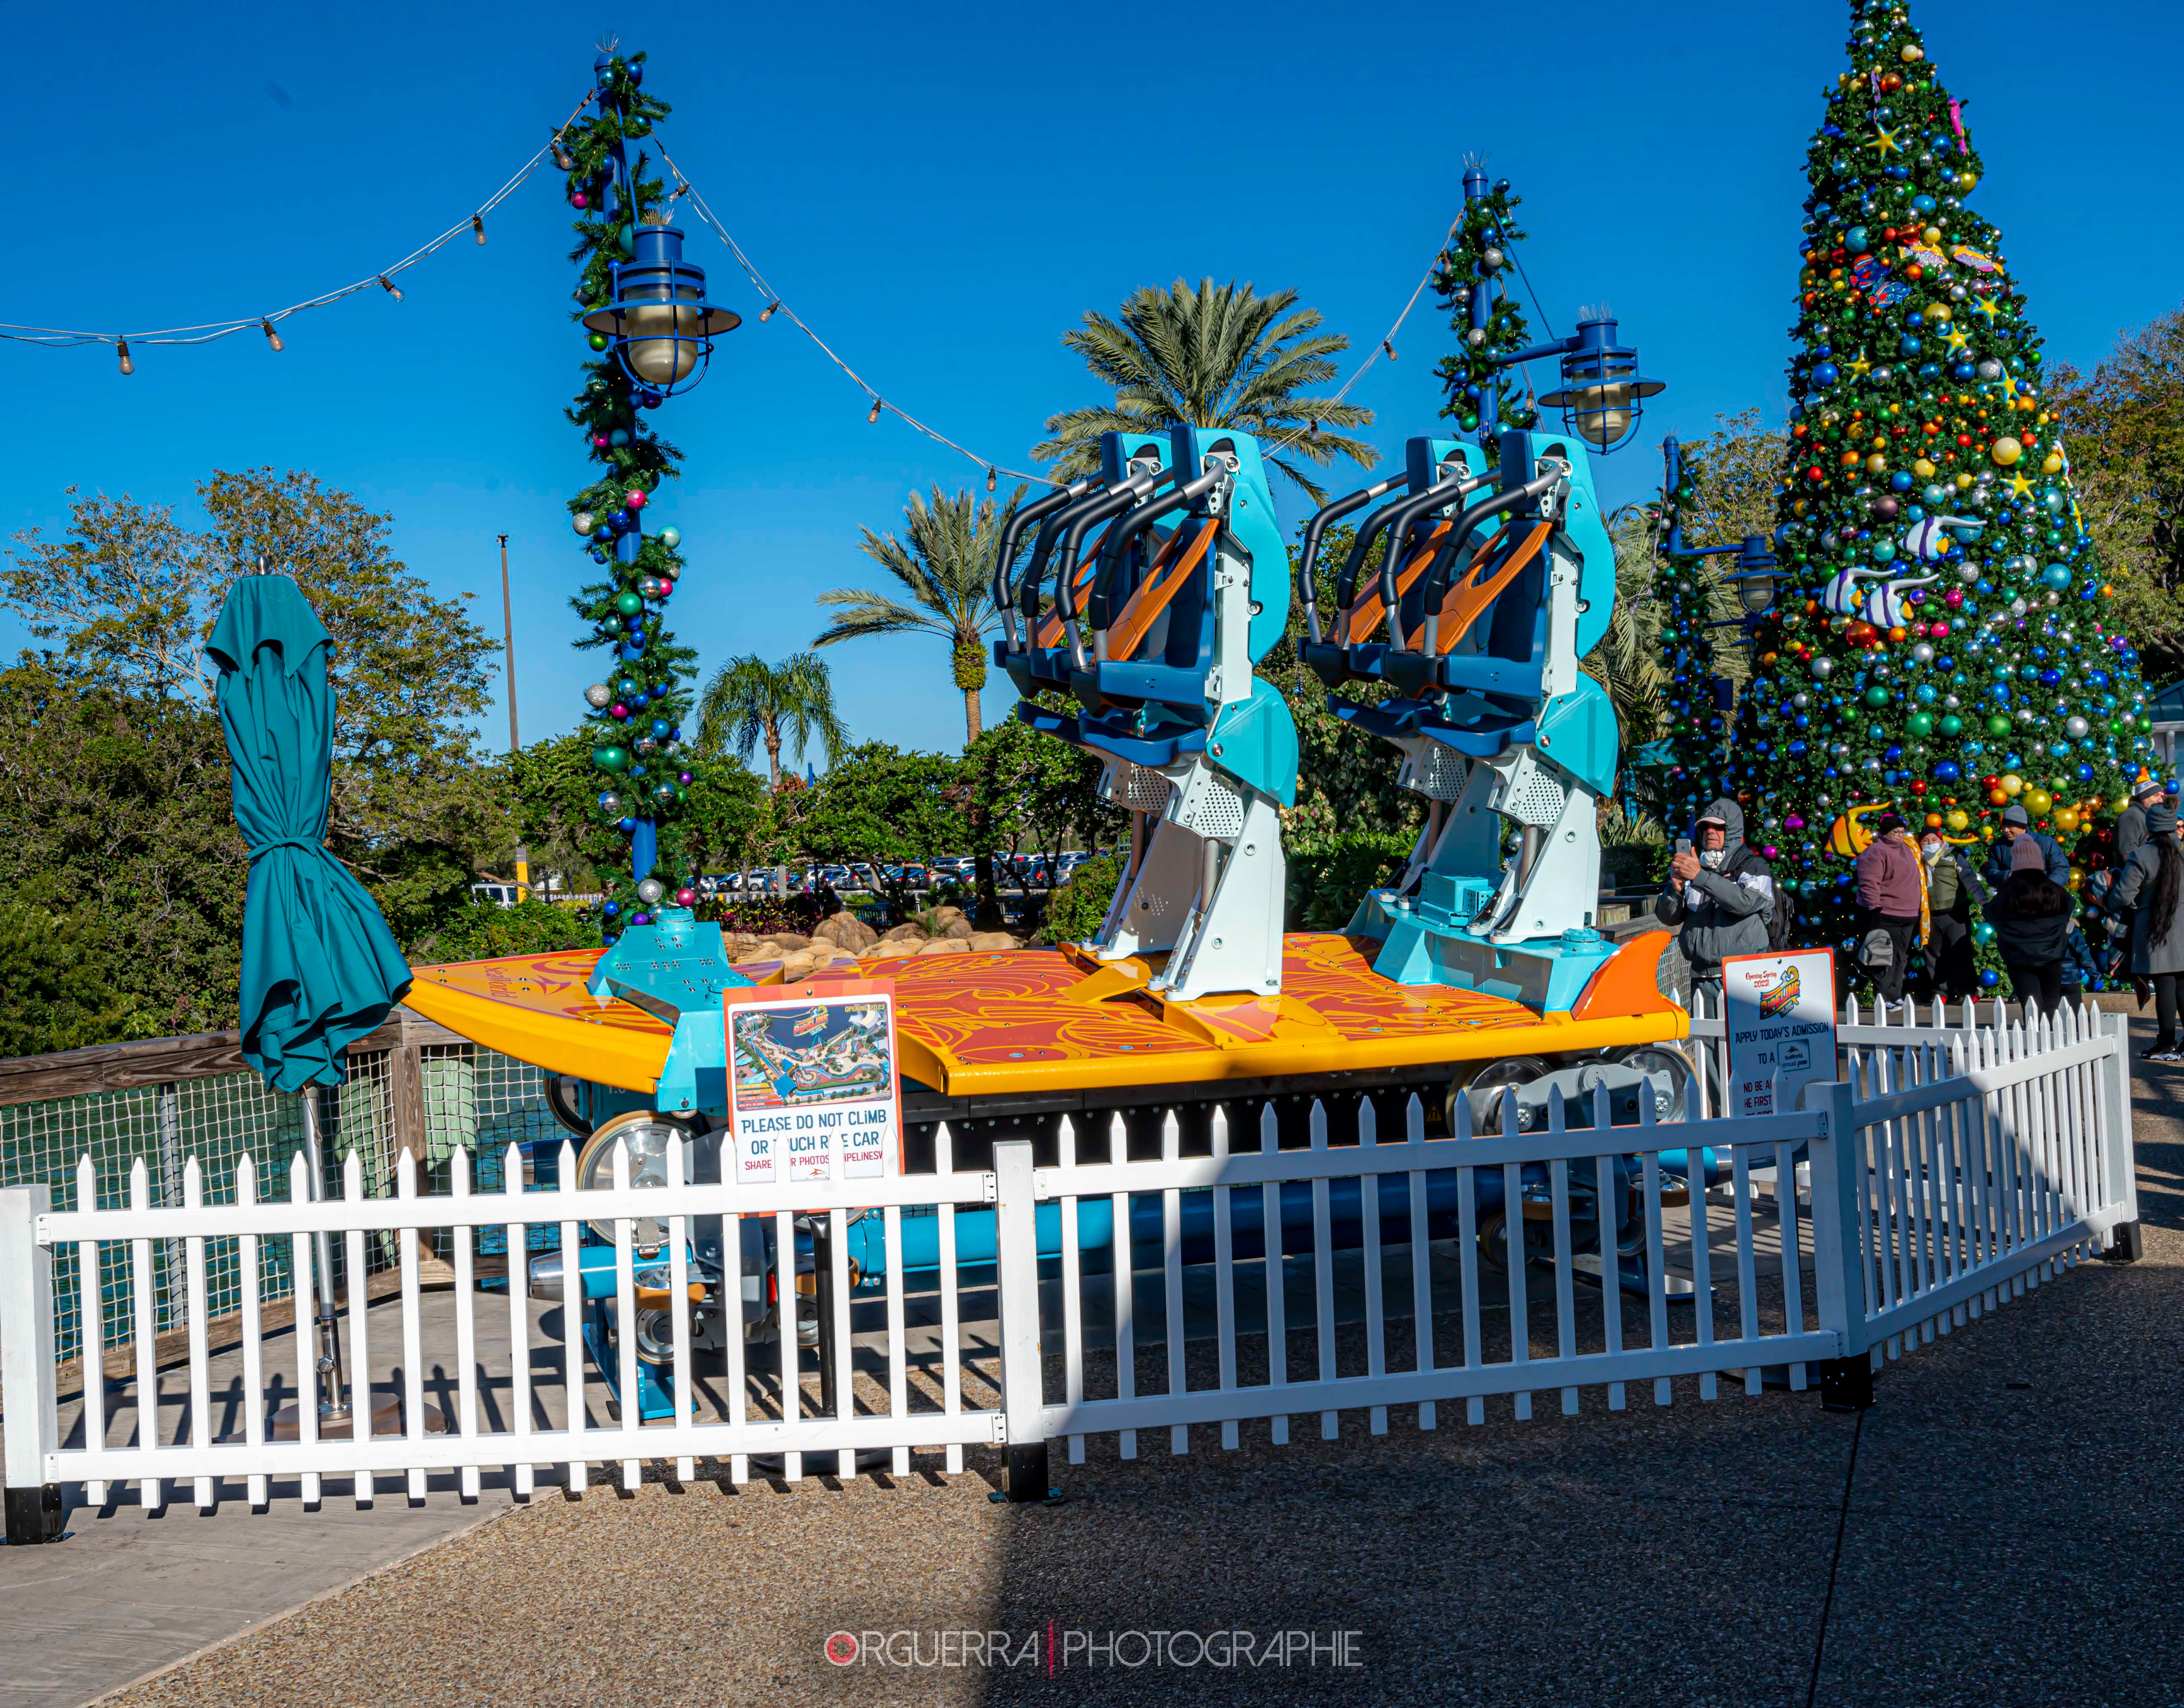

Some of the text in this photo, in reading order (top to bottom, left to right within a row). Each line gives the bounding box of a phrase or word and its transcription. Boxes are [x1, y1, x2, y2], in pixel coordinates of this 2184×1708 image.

[1745, 971, 1777, 980] Opening Spring
[1735, 1031, 1757, 1044] APPLY
[1760, 1026, 1790, 1040] TODAY'S
[1758, 1052, 1775, 1065] TO A
[1798, 1060, 1807, 1068] pass
[1743, 1082, 1753, 1093] ND
[1755, 1081, 1763, 1091] BE
[1754, 1095, 1772, 1107] FIRST
[741, 1116, 791, 1134] PLEASE
[797, 1115, 813, 1129] DO
[819, 1112, 843, 1128] NOT
[751, 1131, 879, 1155] OR UCH RE CAR
[745, 1160, 772, 1170] SHARE
[799, 1155, 829, 1166] PHOTOS
